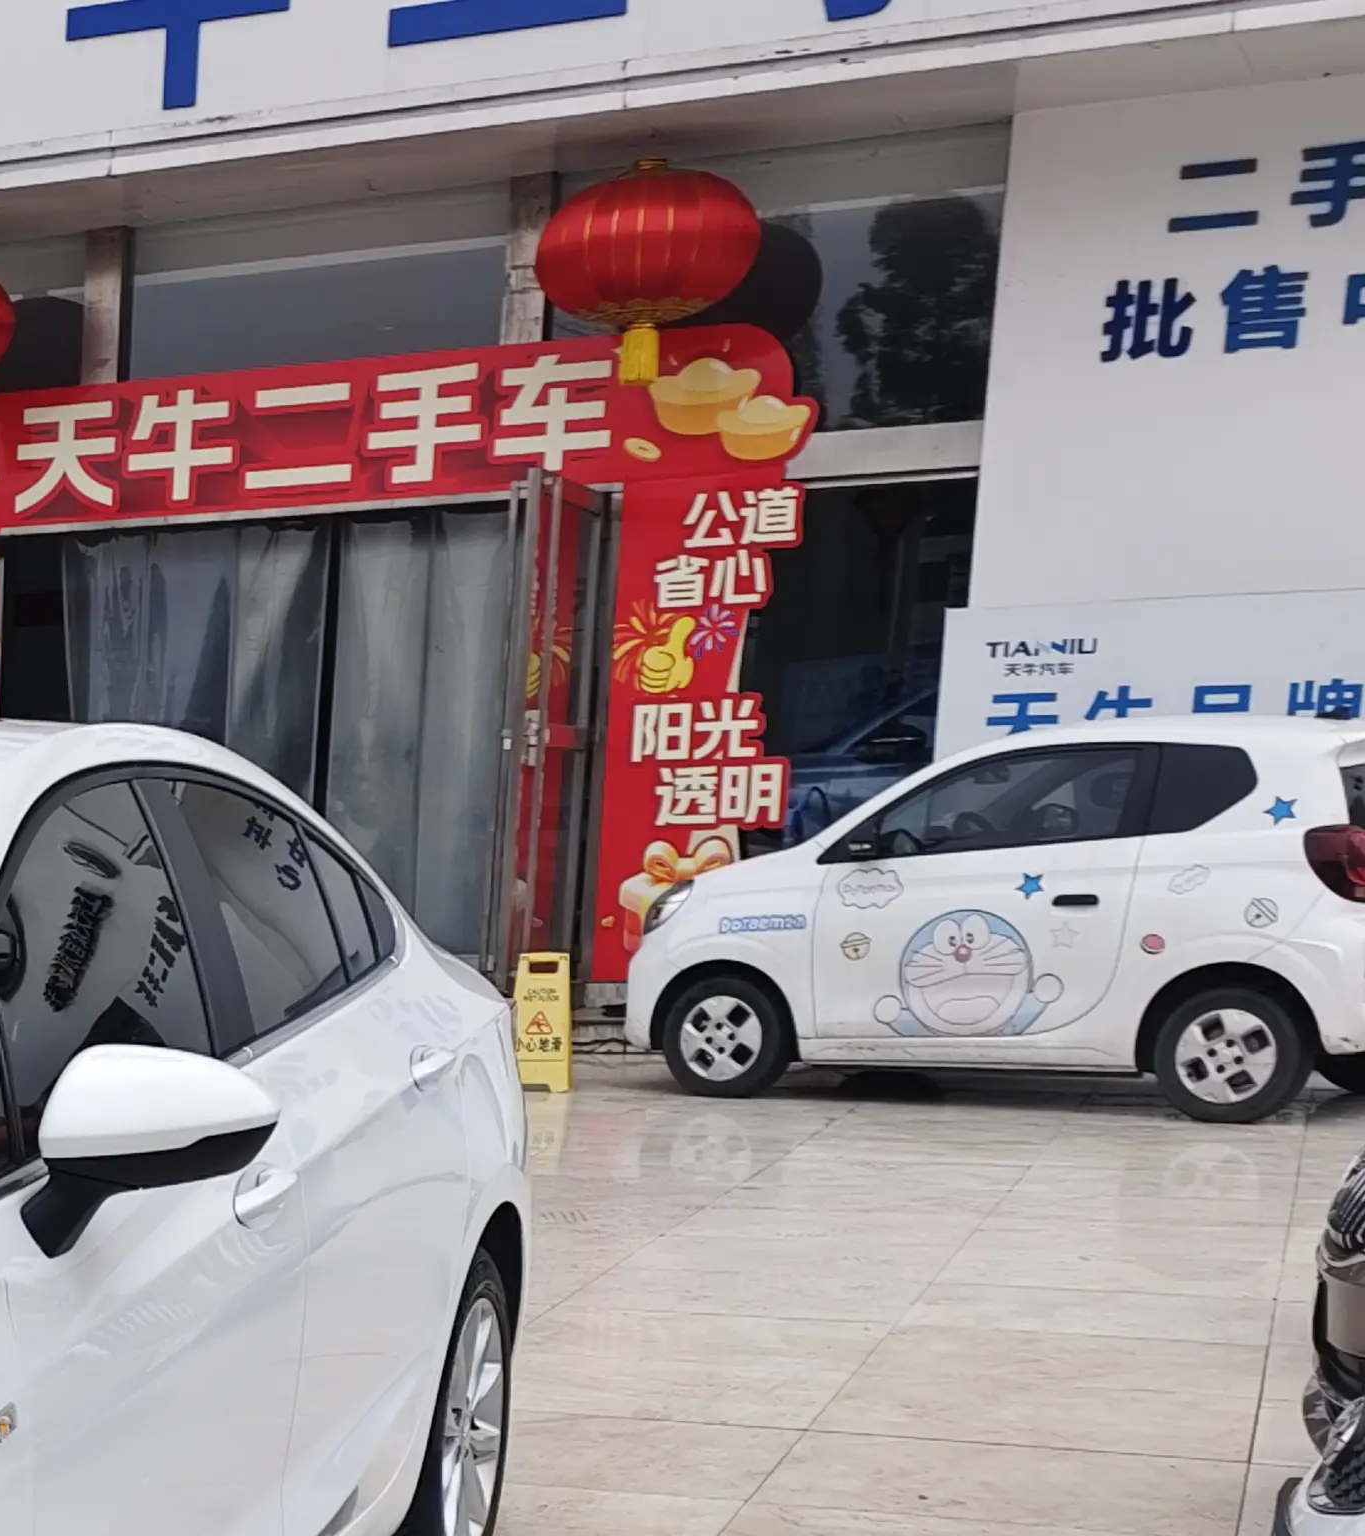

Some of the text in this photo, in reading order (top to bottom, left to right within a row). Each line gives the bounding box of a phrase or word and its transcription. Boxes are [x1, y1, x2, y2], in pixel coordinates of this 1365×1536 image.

[13, 353, 614, 517] 天牛二手车
[683, 485, 799, 549] 公道
[653, 549, 767, 609] 省心
[1003, 661, 1075, 678] 天牛汽车
[630, 698, 760, 763] 阳光
[654, 763, 784, 827] 透明
